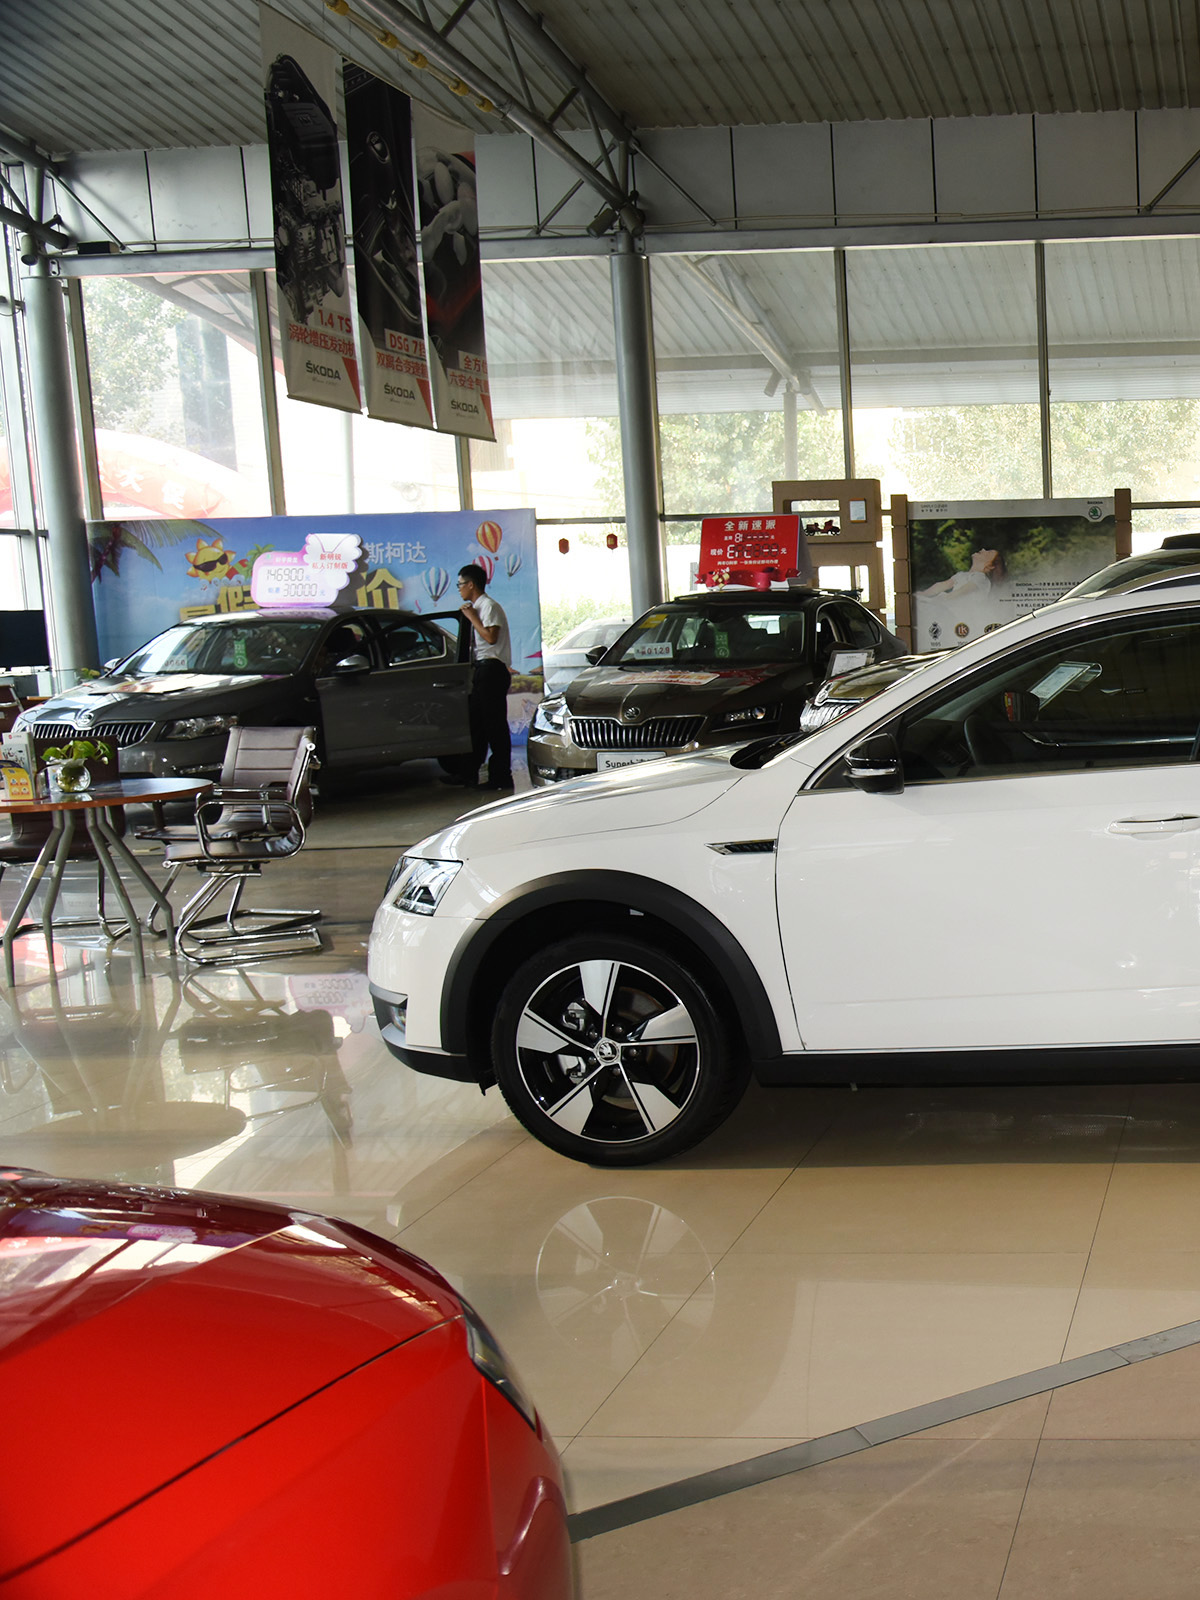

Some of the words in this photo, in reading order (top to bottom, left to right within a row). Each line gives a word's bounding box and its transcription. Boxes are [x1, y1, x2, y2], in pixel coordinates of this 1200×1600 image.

[318, 309, 334, 328] 1.4
[389, 333, 410, 352] DSG
[724, 519, 776, 532] 全新速派
[364, 541, 428, 565] 斯柯达
[283, 583, 318, 597] 30000
